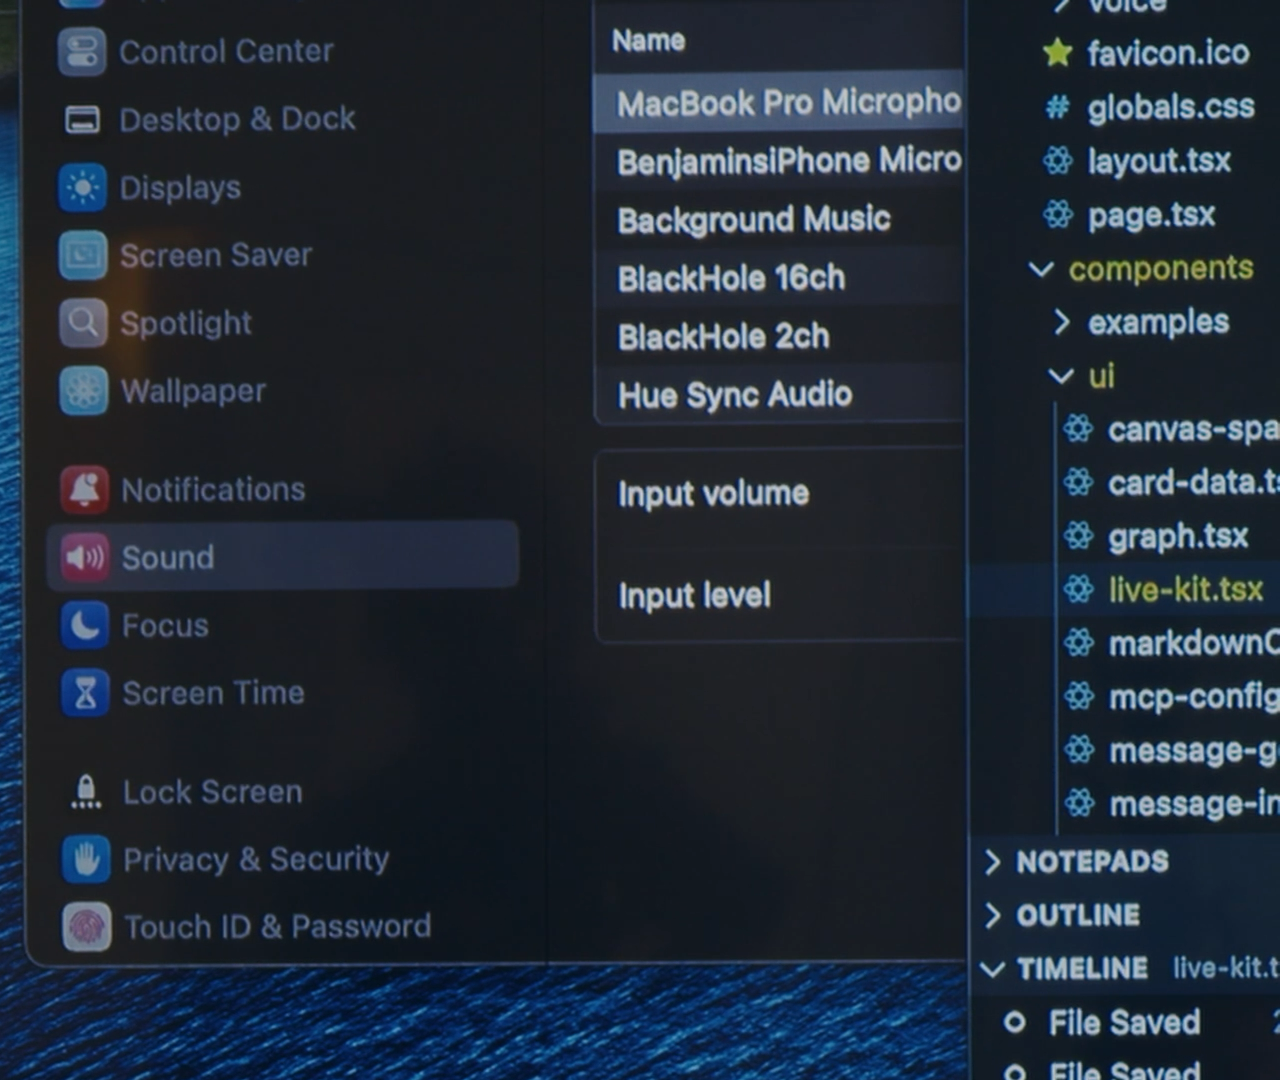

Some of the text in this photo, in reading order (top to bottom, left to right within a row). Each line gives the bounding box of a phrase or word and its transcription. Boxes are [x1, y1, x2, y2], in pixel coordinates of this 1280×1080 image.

[1089, 0, 1168, 13] voice
[118, 37, 335, 65] Control Center
[612, 28, 686, 53] Name
[1086, 37, 1251, 68] favicon.ico
[617, 85, 961, 120] MacBook Pro Micropho
[1087, 91, 1256, 127] globals.css
[119, 104, 356, 137] Desktop & Dock
[617, 144, 963, 182] BenjaminsiPhone Micro
[1088, 146, 1232, 181] layout.tsx
[120, 174, 242, 206] Displays
[617, 202, 891, 240] Background Music
[1088, 201, 1216, 234] page.tsx
[119, 241, 313, 270] Screen Saver
[1069, 254, 1254, 287] components
[617, 262, 846, 293] BlackHole 16ch
[119, 308, 252, 342] Spotlight
[618, 320, 830, 351] BlackHole 2ch
[1087, 306, 1230, 341] examples
[1089, 361, 1115, 389] ui
[120, 377, 267, 408] Wallpaper
[618, 378, 853, 415] Hue Sync Audio
[1107, 419, 1280, 447] canvas-spa
[121, 475, 306, 503] Notifications
[618, 477, 810, 511] Input volume
[1107, 466, 1280, 497] card-data.t
[1107, 520, 1249, 556] graph.tsx
[121, 544, 215, 571] Sound
[619, 579, 771, 615] Input level
[1110, 574, 1264, 603] live-kit.tsx
[122, 612, 209, 638] Focus
[122, 678, 305, 706] Screen Time
[1109, 680, 1280, 716] mcp-config
[1109, 740, 1280, 769] message-g
[123, 778, 303, 805] Lock Screen
[123, 844, 390, 878] Privacy & Security
[1016, 849, 1169, 874] NOTEPADS
[123, 911, 431, 940] Touch ID & Password
[1015, 902, 1140, 928] OUTLINE
[1015, 955, 1148, 981] TIMELINE
[1049, 1007, 1201, 1037] File Saved
